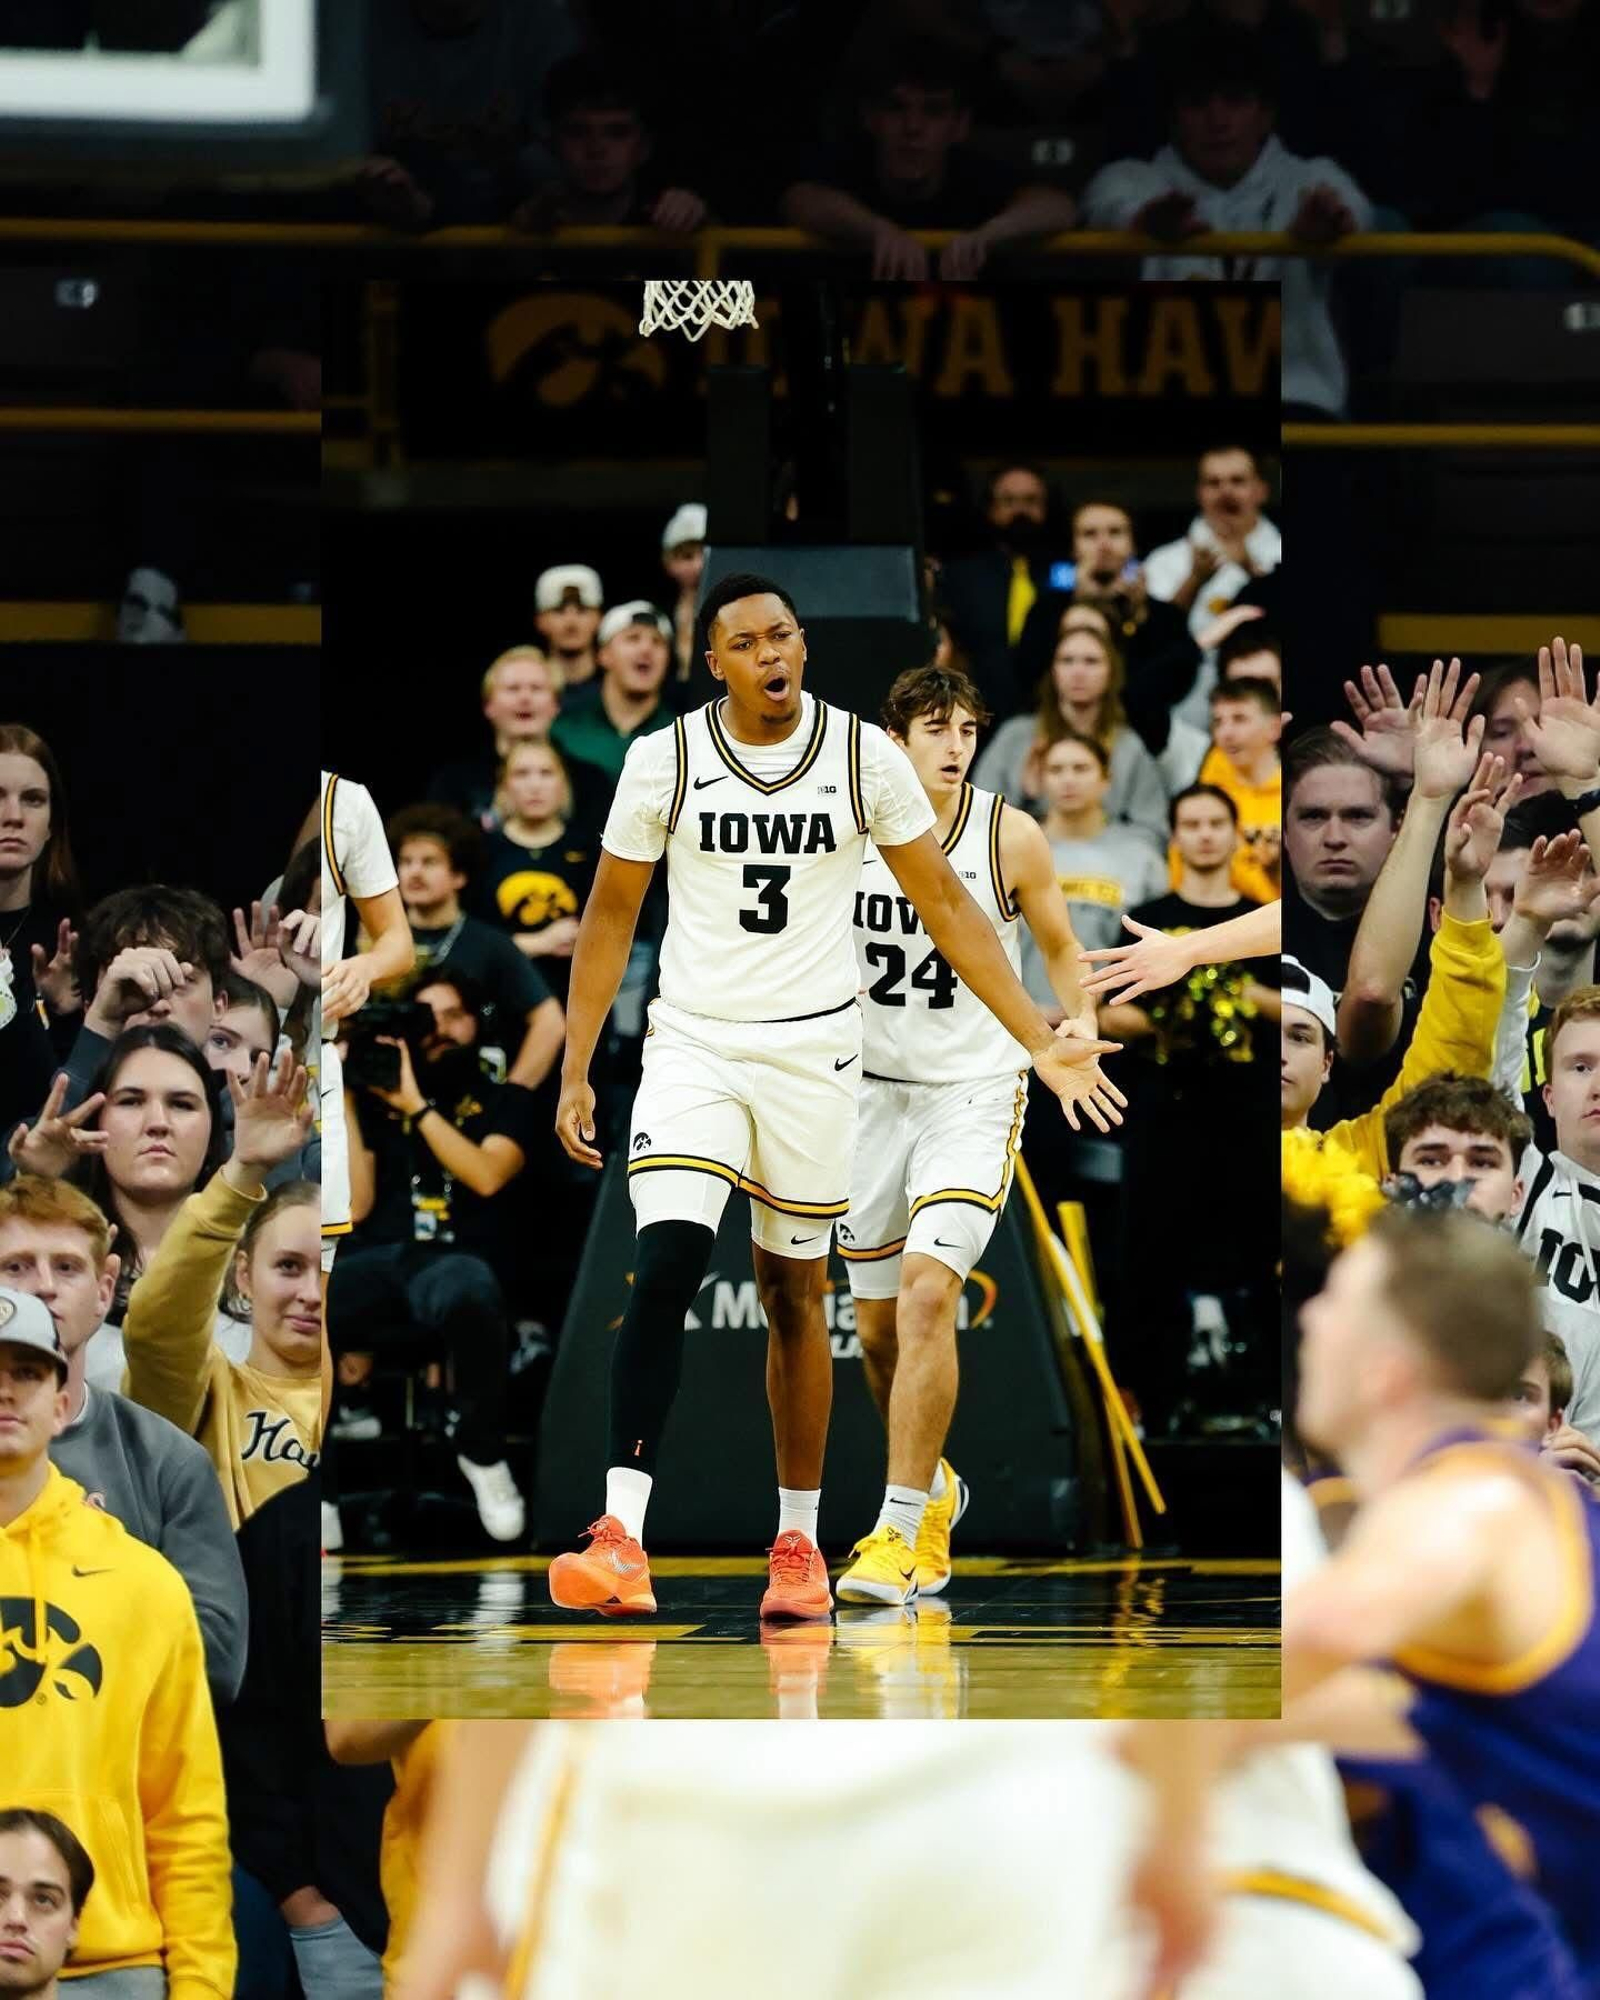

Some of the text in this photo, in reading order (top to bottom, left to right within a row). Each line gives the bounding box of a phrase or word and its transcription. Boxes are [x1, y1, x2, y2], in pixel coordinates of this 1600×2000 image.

[699, 812, 837, 854] IOWA
[739, 864, 791, 934] 3
[853, 891, 928, 935] IOW
[865, 941, 958, 1009] 24
[1538, 1227, 1600, 1303] IO
